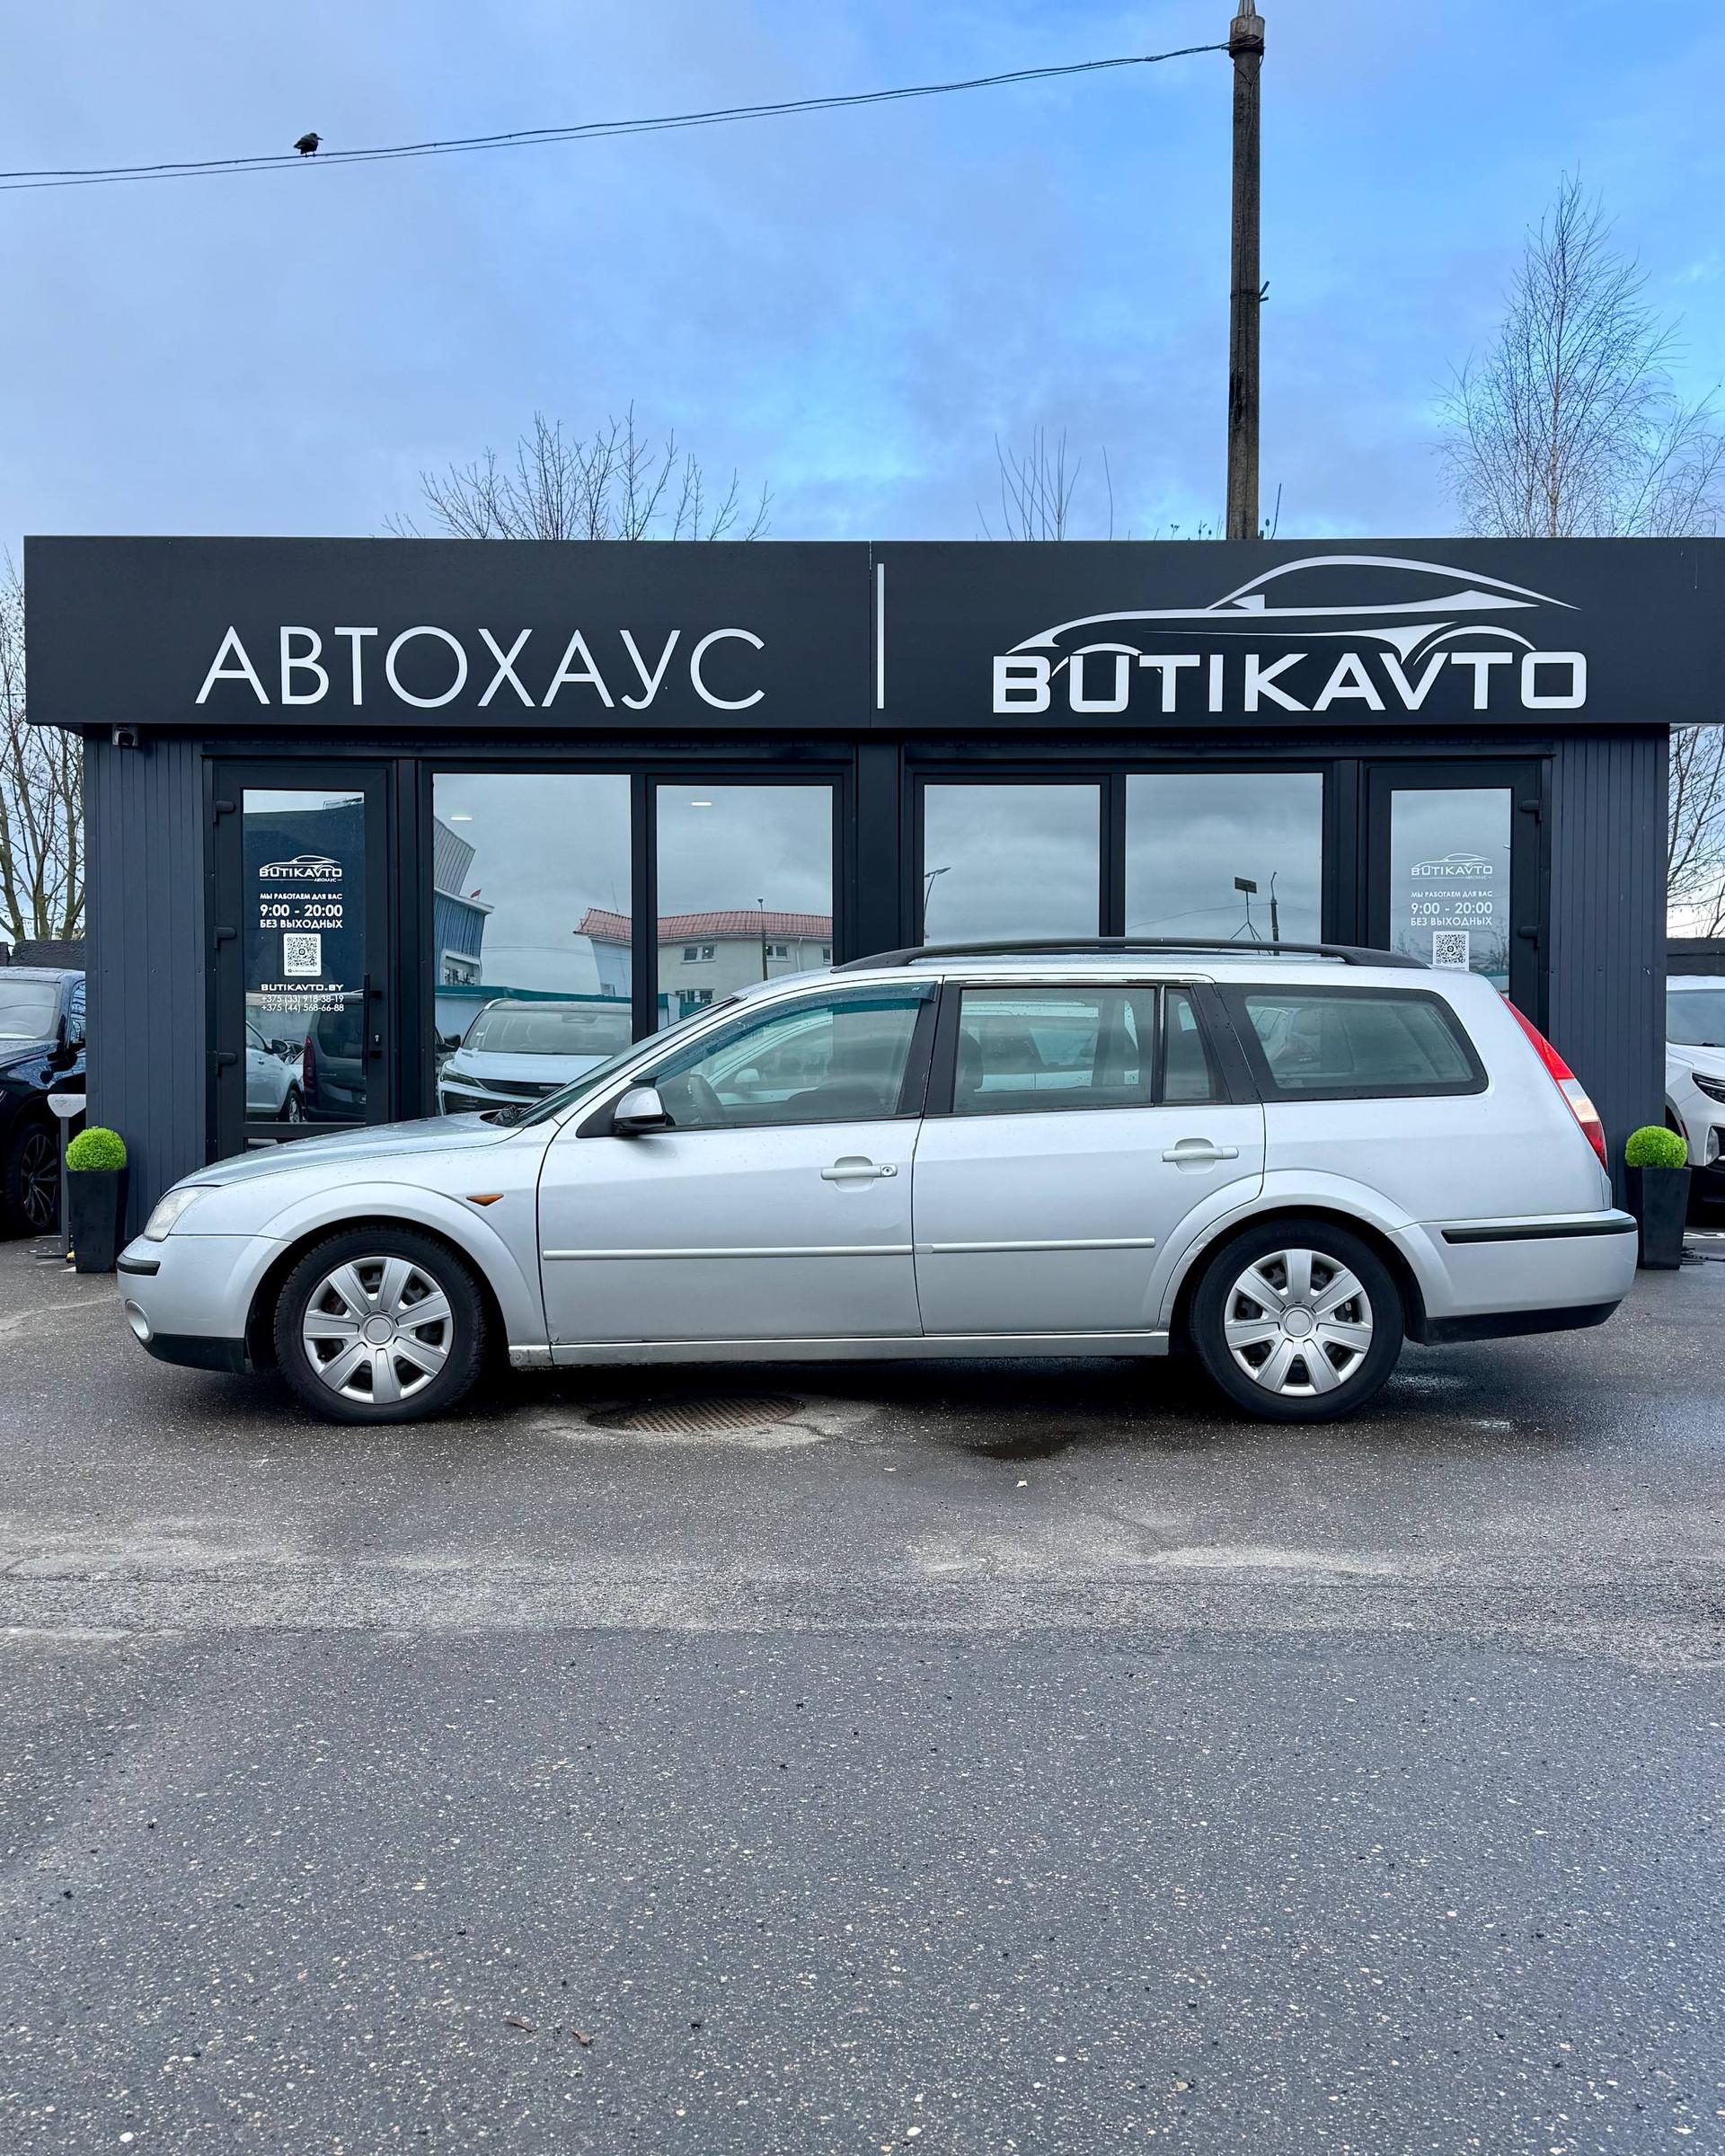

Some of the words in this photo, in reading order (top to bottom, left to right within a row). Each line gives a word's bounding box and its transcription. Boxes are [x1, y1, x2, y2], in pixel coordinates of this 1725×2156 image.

[195, 625, 765, 710] АВТОХАУС
[993, 650, 1588, 713] BUTIKAVTO
[259, 868, 342, 878] BUTIKAVTO
[1411, 865, 1493, 876] BUTIKAVTO
[260, 904, 290, 917] 9:00
[304, 904, 343, 917] 20:00
[1411, 903, 1440, 915] 9:00
[1455, 902, 1493, 915] 20:00
[260, 919, 278, 929] БЕЗ
[280, 919, 343, 930] ВЫХОДНЫХ
[1411, 917, 1428, 926] БЕЗ
[1430, 916, 1492, 926] ВЫХОДНЫХ
[261, 984, 344, 992] BUTIKAVTO.BY
[261, 994, 282, 1003] +375
[285, 994, 301, 1004] (33)
[303, 994, 344, 1003] 918-38-19
[261, 1003, 282, 1012] +375
[285, 1003, 301, 1013] (44)
[303, 1003, 344, 1012] 568-66-88
